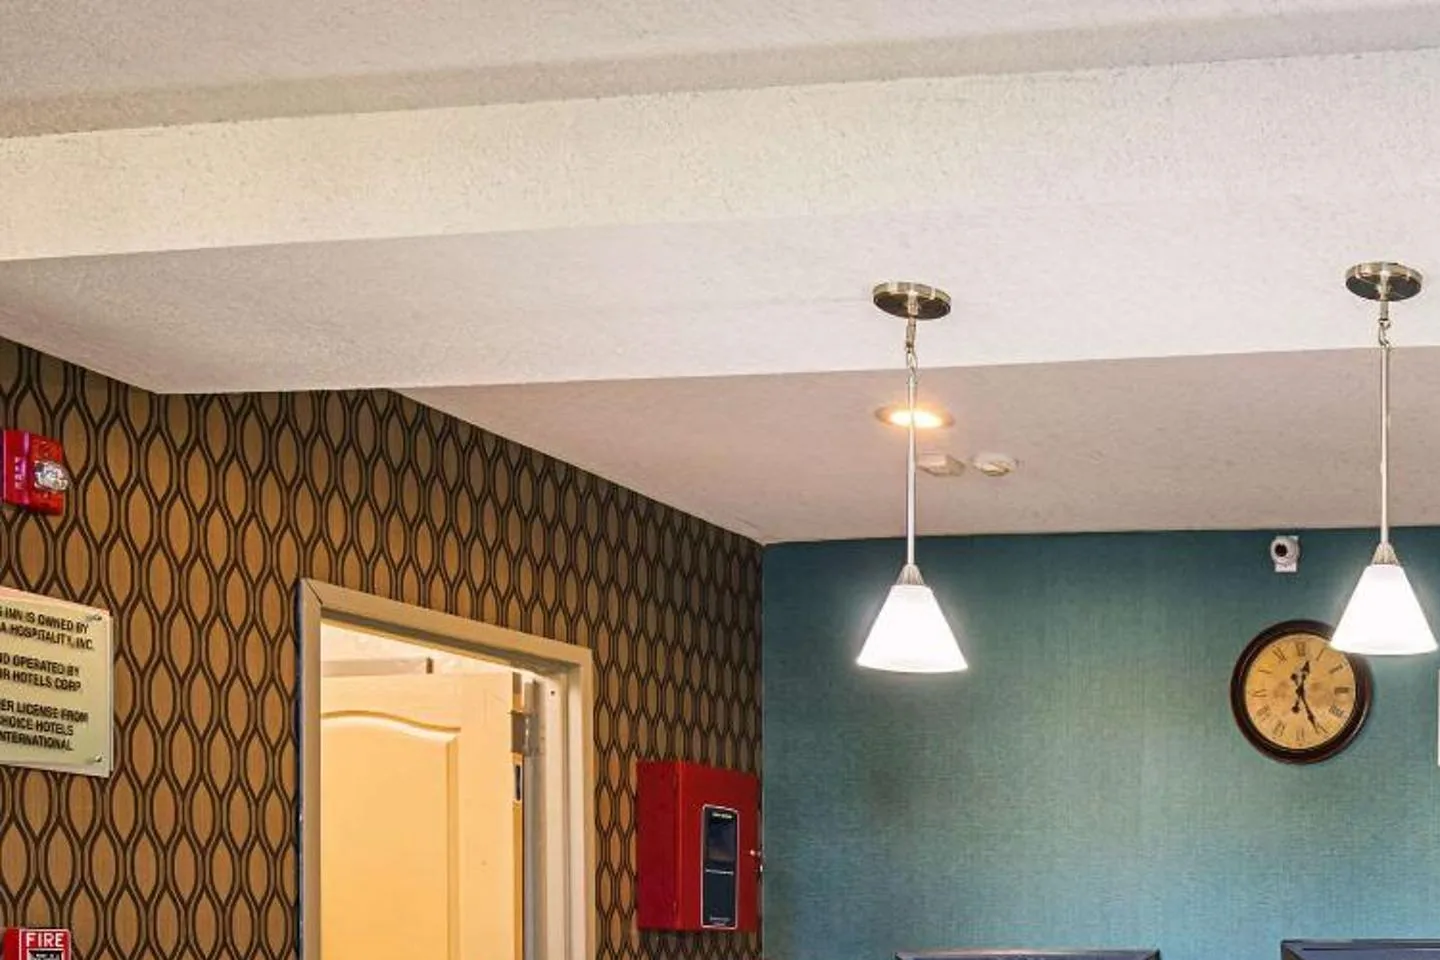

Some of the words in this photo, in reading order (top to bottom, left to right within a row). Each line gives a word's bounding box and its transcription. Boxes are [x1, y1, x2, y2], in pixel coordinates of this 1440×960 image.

[37, 613, 74, 632] OWNED
[75, 621, 89, 634] BY
[13, 654, 66, 676] OPERATED
[66, 665, 80, 677] BY
[12, 670, 53, 689] HOTELS
[16, 701, 59, 719] LICENSE
[60, 708, 89, 723] FROM
[35, 719, 74, 736] HOTELS
[26, 932, 65, 948] FIRE
